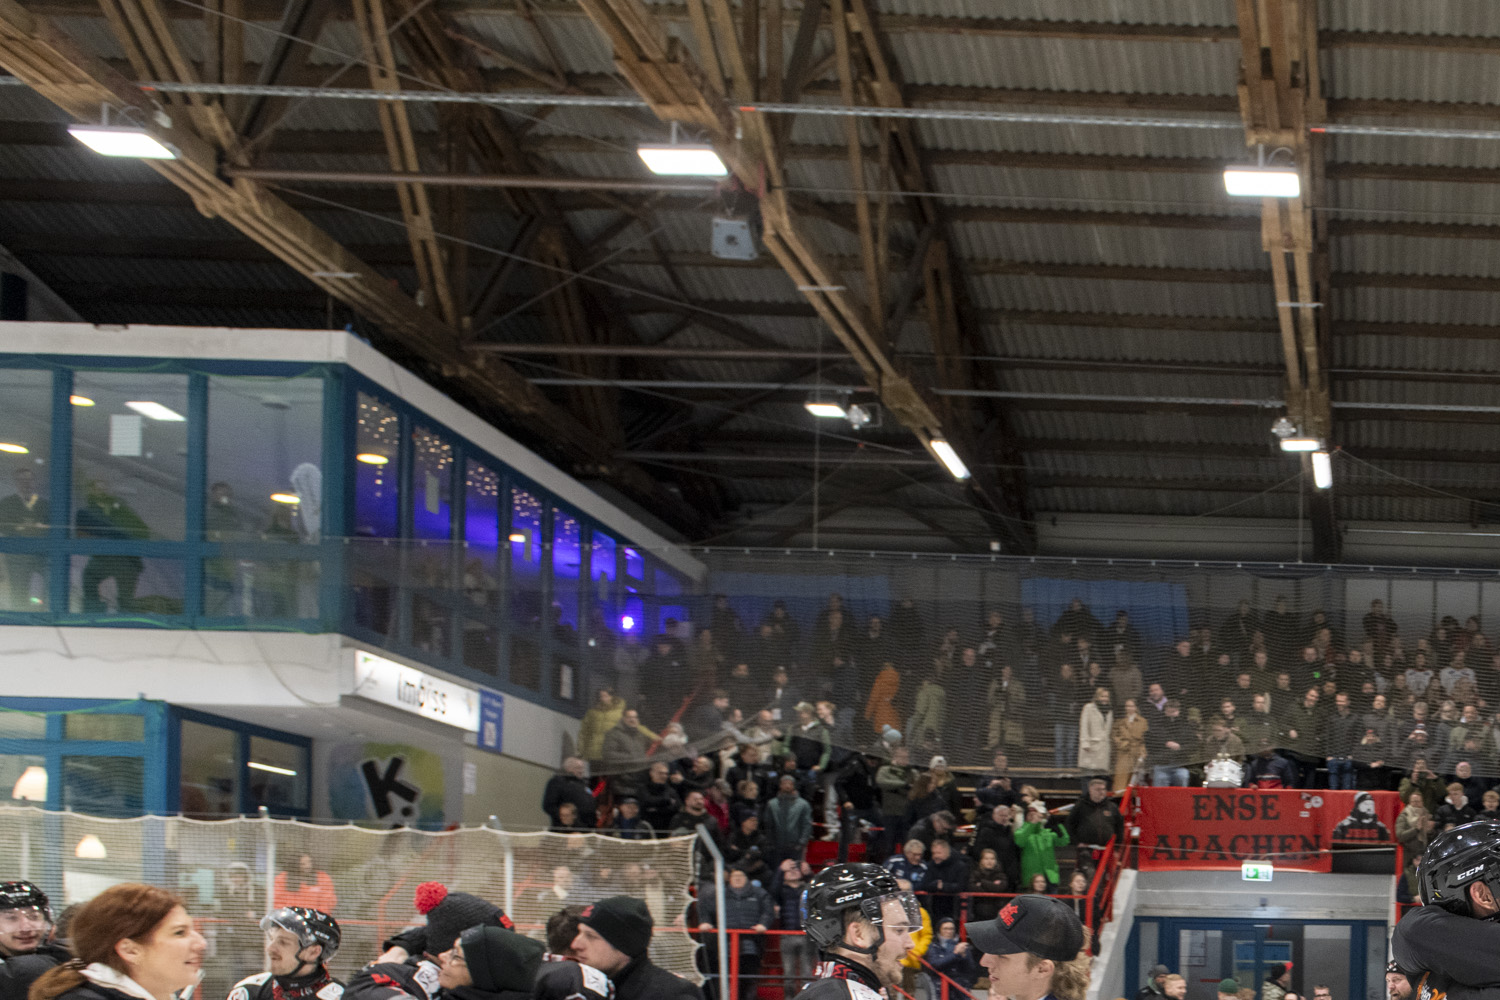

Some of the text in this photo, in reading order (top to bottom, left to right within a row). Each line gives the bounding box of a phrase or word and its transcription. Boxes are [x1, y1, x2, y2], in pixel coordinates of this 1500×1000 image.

[1192, 794, 1281, 821] ENSE
[1150, 834, 1322, 861] APACHEN
[1456, 863, 1485, 881] CCM
